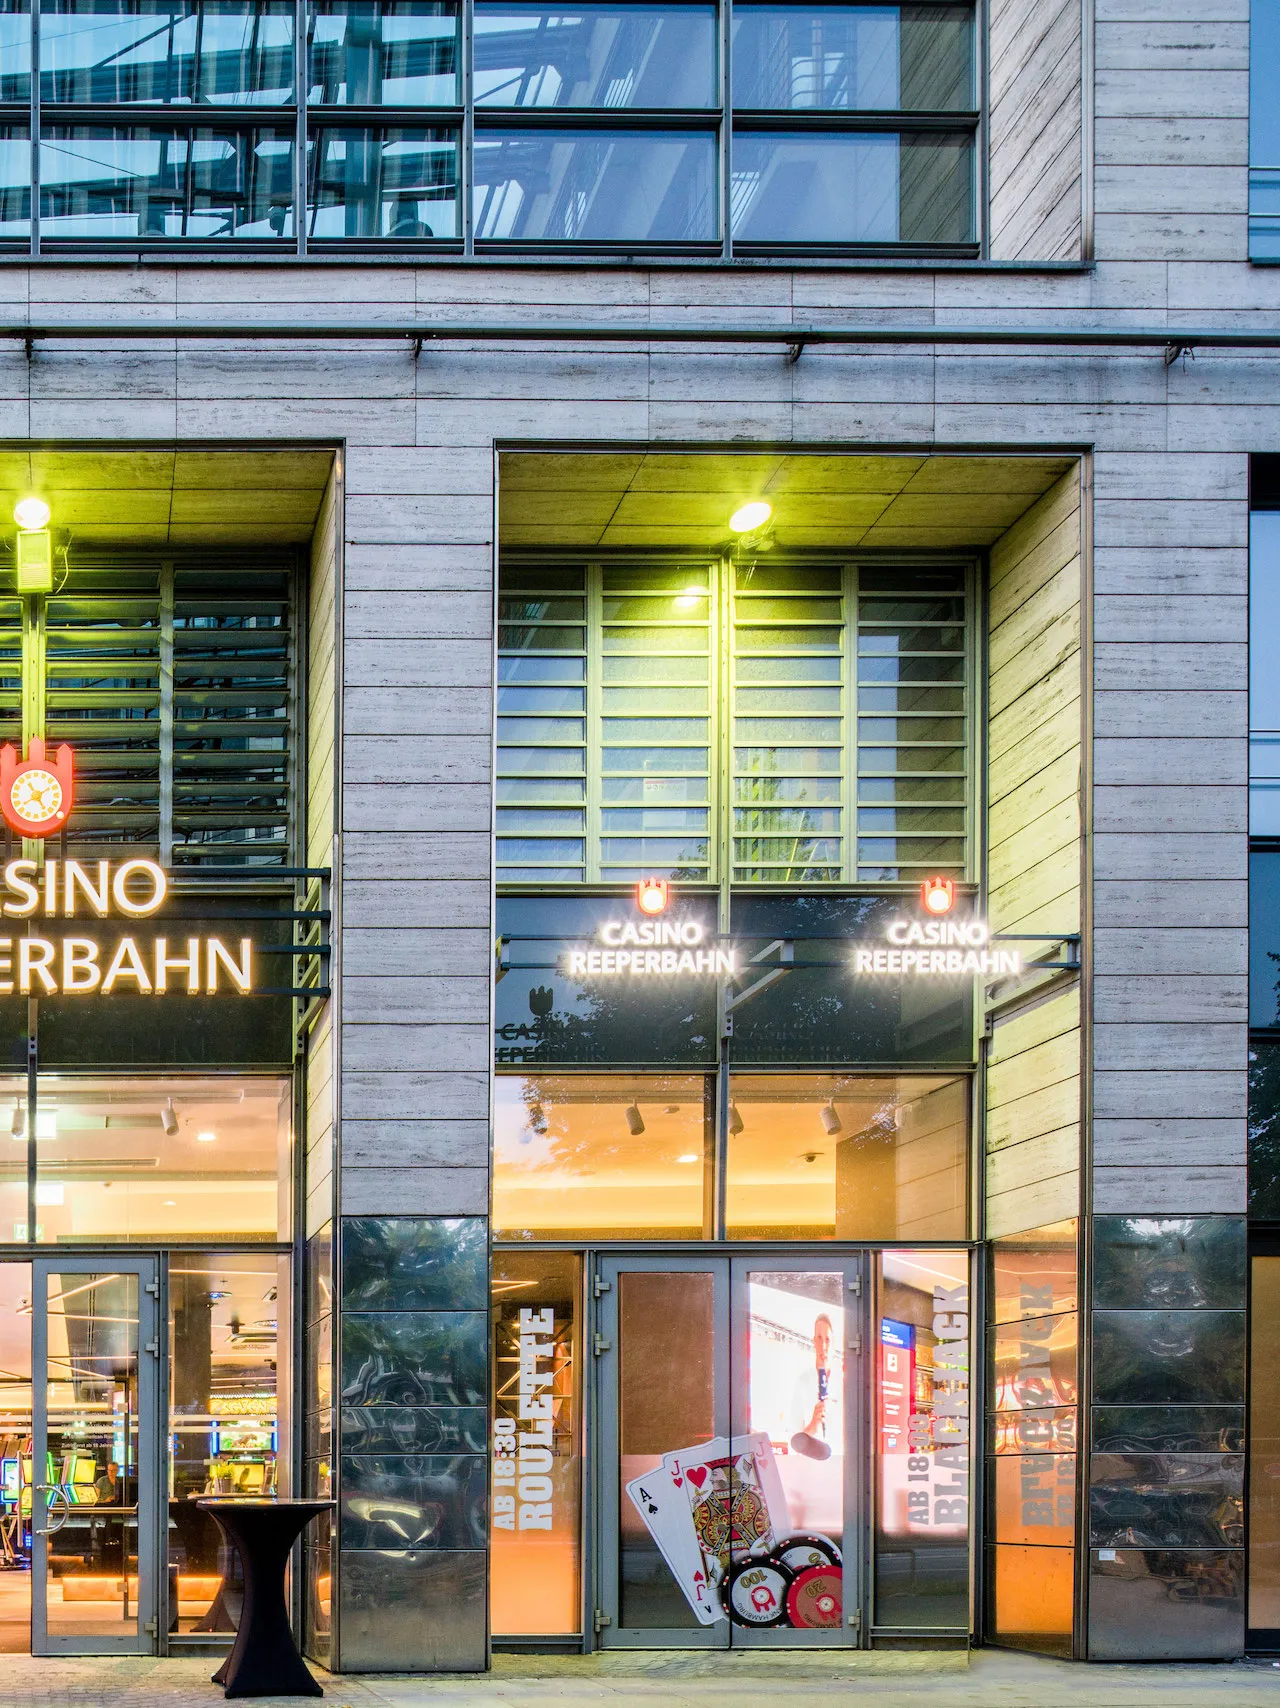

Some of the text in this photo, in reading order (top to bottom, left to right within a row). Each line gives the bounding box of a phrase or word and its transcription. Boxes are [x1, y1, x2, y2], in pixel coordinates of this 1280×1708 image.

[601, 921, 703, 945] CASINO
[887, 920, 988, 945] CASINO
[569, 950, 736, 974] REEPERBAHN
[856, 949, 1021, 973] REEPERBAHN
[933, 1285, 969, 1526] BLACKJACK
[518, 1308, 554, 1531] ROULETTE
[493, 1418, 516, 1531] AB 18:30
[671, 1460, 681, 1476] J
[639, 1487, 652, 1502] A
[908, 1491, 930, 1526] AB
[740, 1569, 768, 1588] 100
[805, 1579, 827, 1598] 20
[737, 1602, 769, 1622] HAMBURG
